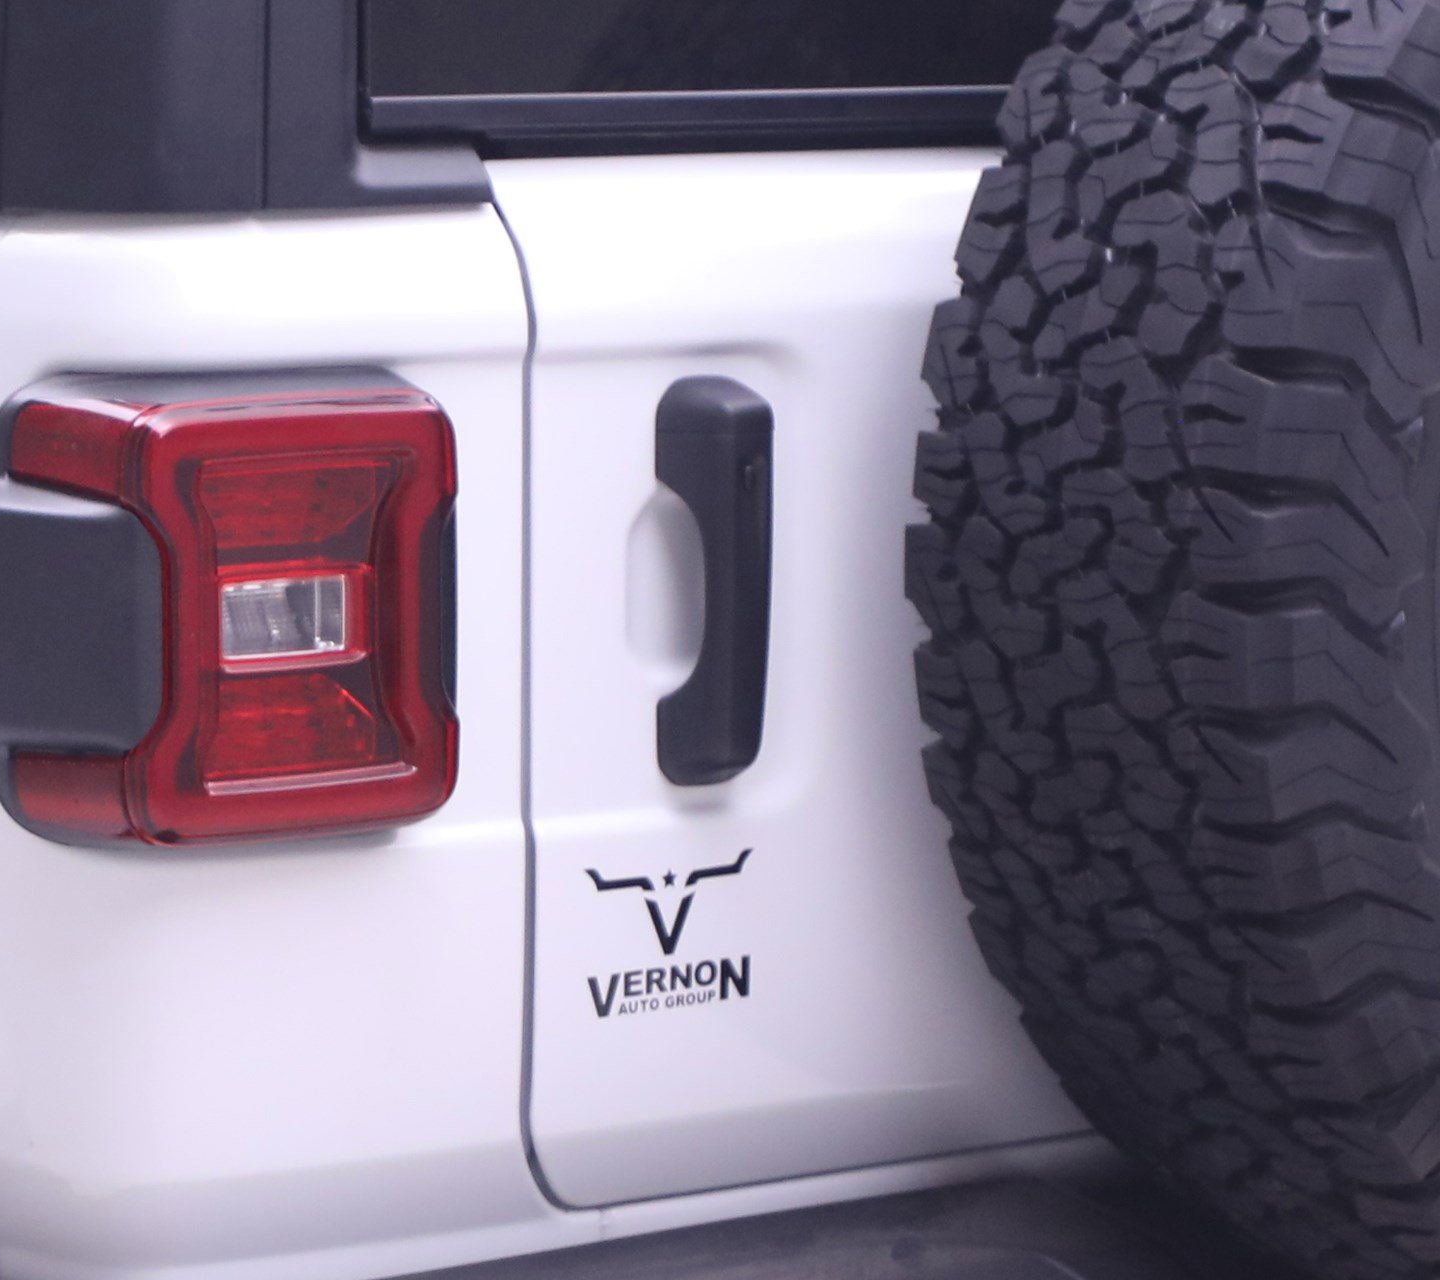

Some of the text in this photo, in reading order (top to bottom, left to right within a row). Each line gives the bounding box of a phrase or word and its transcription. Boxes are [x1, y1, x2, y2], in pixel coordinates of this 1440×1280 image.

[586, 954, 752, 1018] VERNON
[617, 987, 717, 1017] AUTO GROUP
